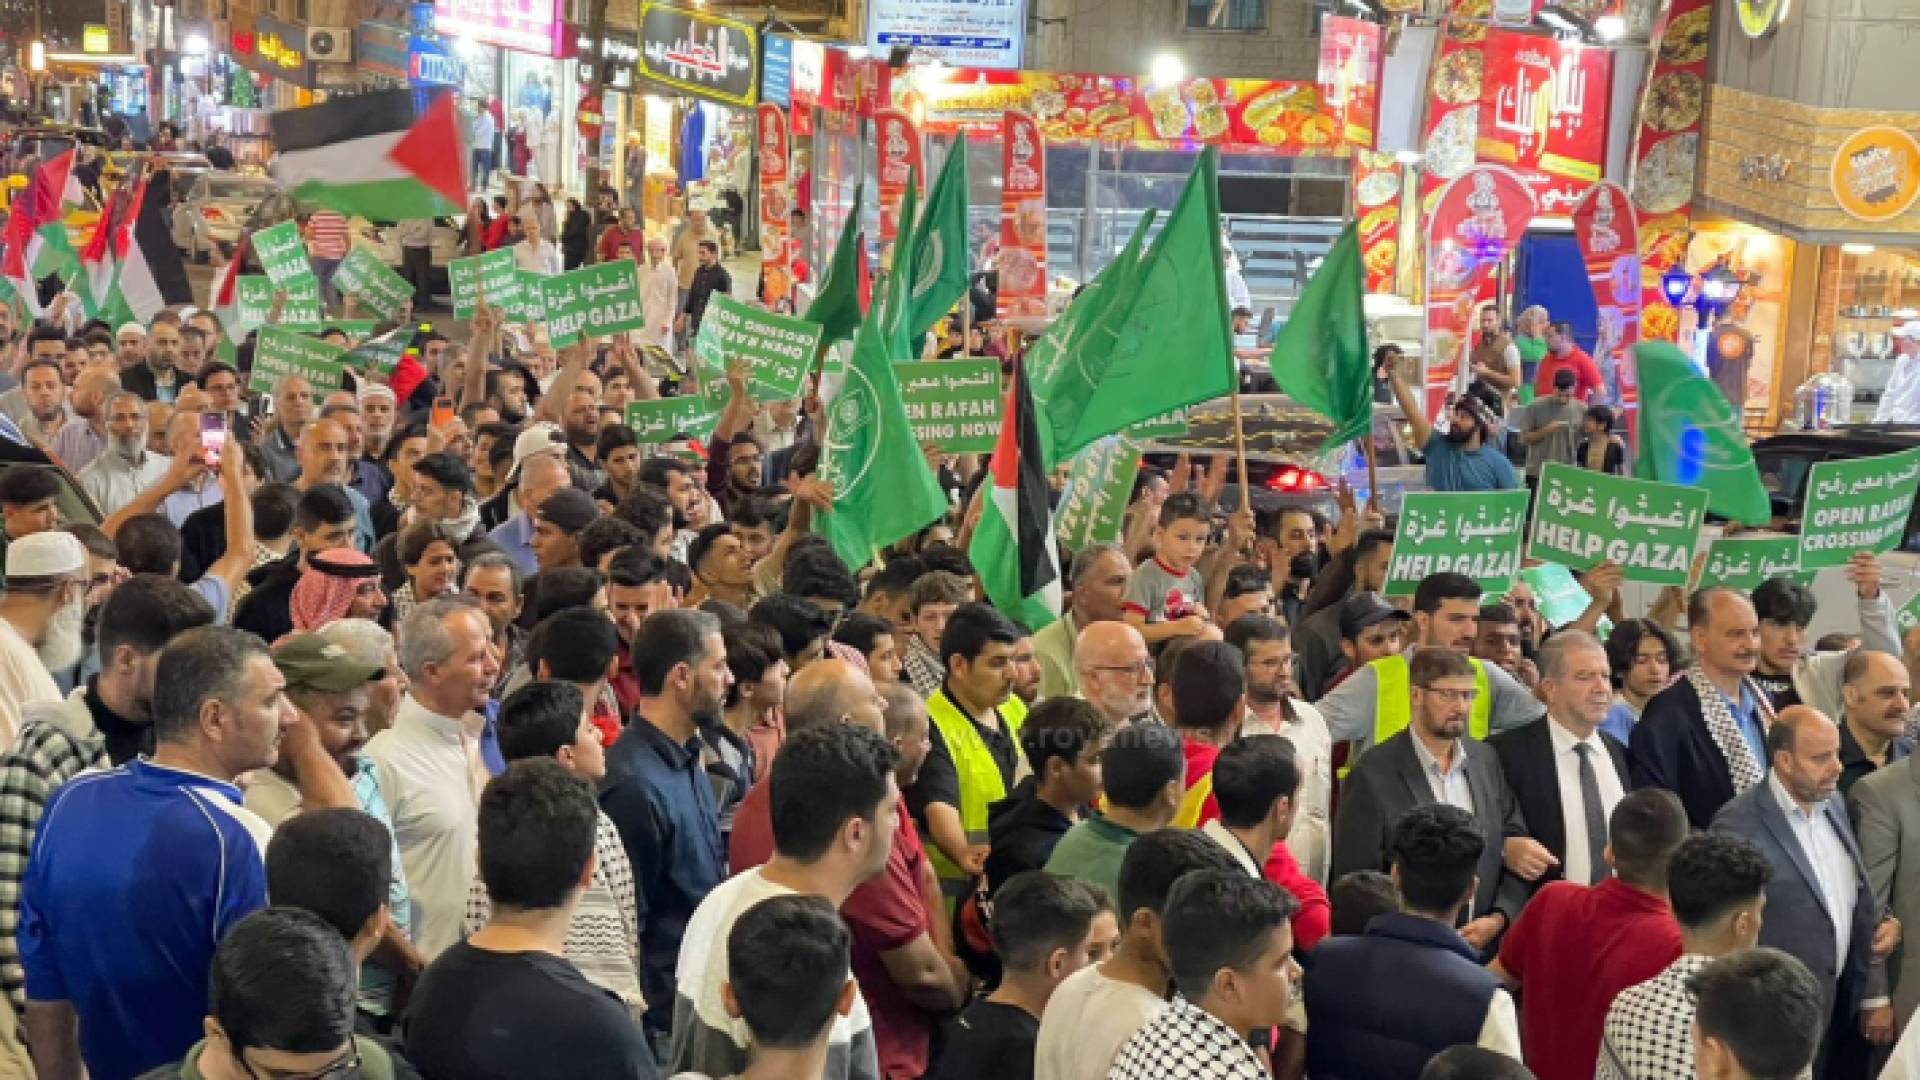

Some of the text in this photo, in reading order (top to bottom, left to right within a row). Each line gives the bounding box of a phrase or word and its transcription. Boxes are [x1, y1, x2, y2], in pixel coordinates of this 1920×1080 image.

[547, 283, 576, 312] غزة
[580, 270, 635, 302] اغيثوا
[550, 300, 641, 339] HELP GAZA
[906, 367, 995, 394] افتحوا معبر
[631, 409, 666, 436] غزة
[904, 399, 995, 420] EN RAFAH
[960, 421, 1002, 437] NOW
[1816, 472, 1847, 500] رفح
[1849, 475, 1883, 496] معبر
[1547, 478, 1697, 537] اغيثوا غزة
[1815, 505, 1865, 528] OPEN
[1404, 505, 1521, 545] اغيثوا غزة
[1804, 525, 1884, 551] CROSSING
[1536, 521, 1688, 573] HELP GAZA
[1452, 550, 1514, 580] GAZA
[1708, 551, 1751, 582] غزة
